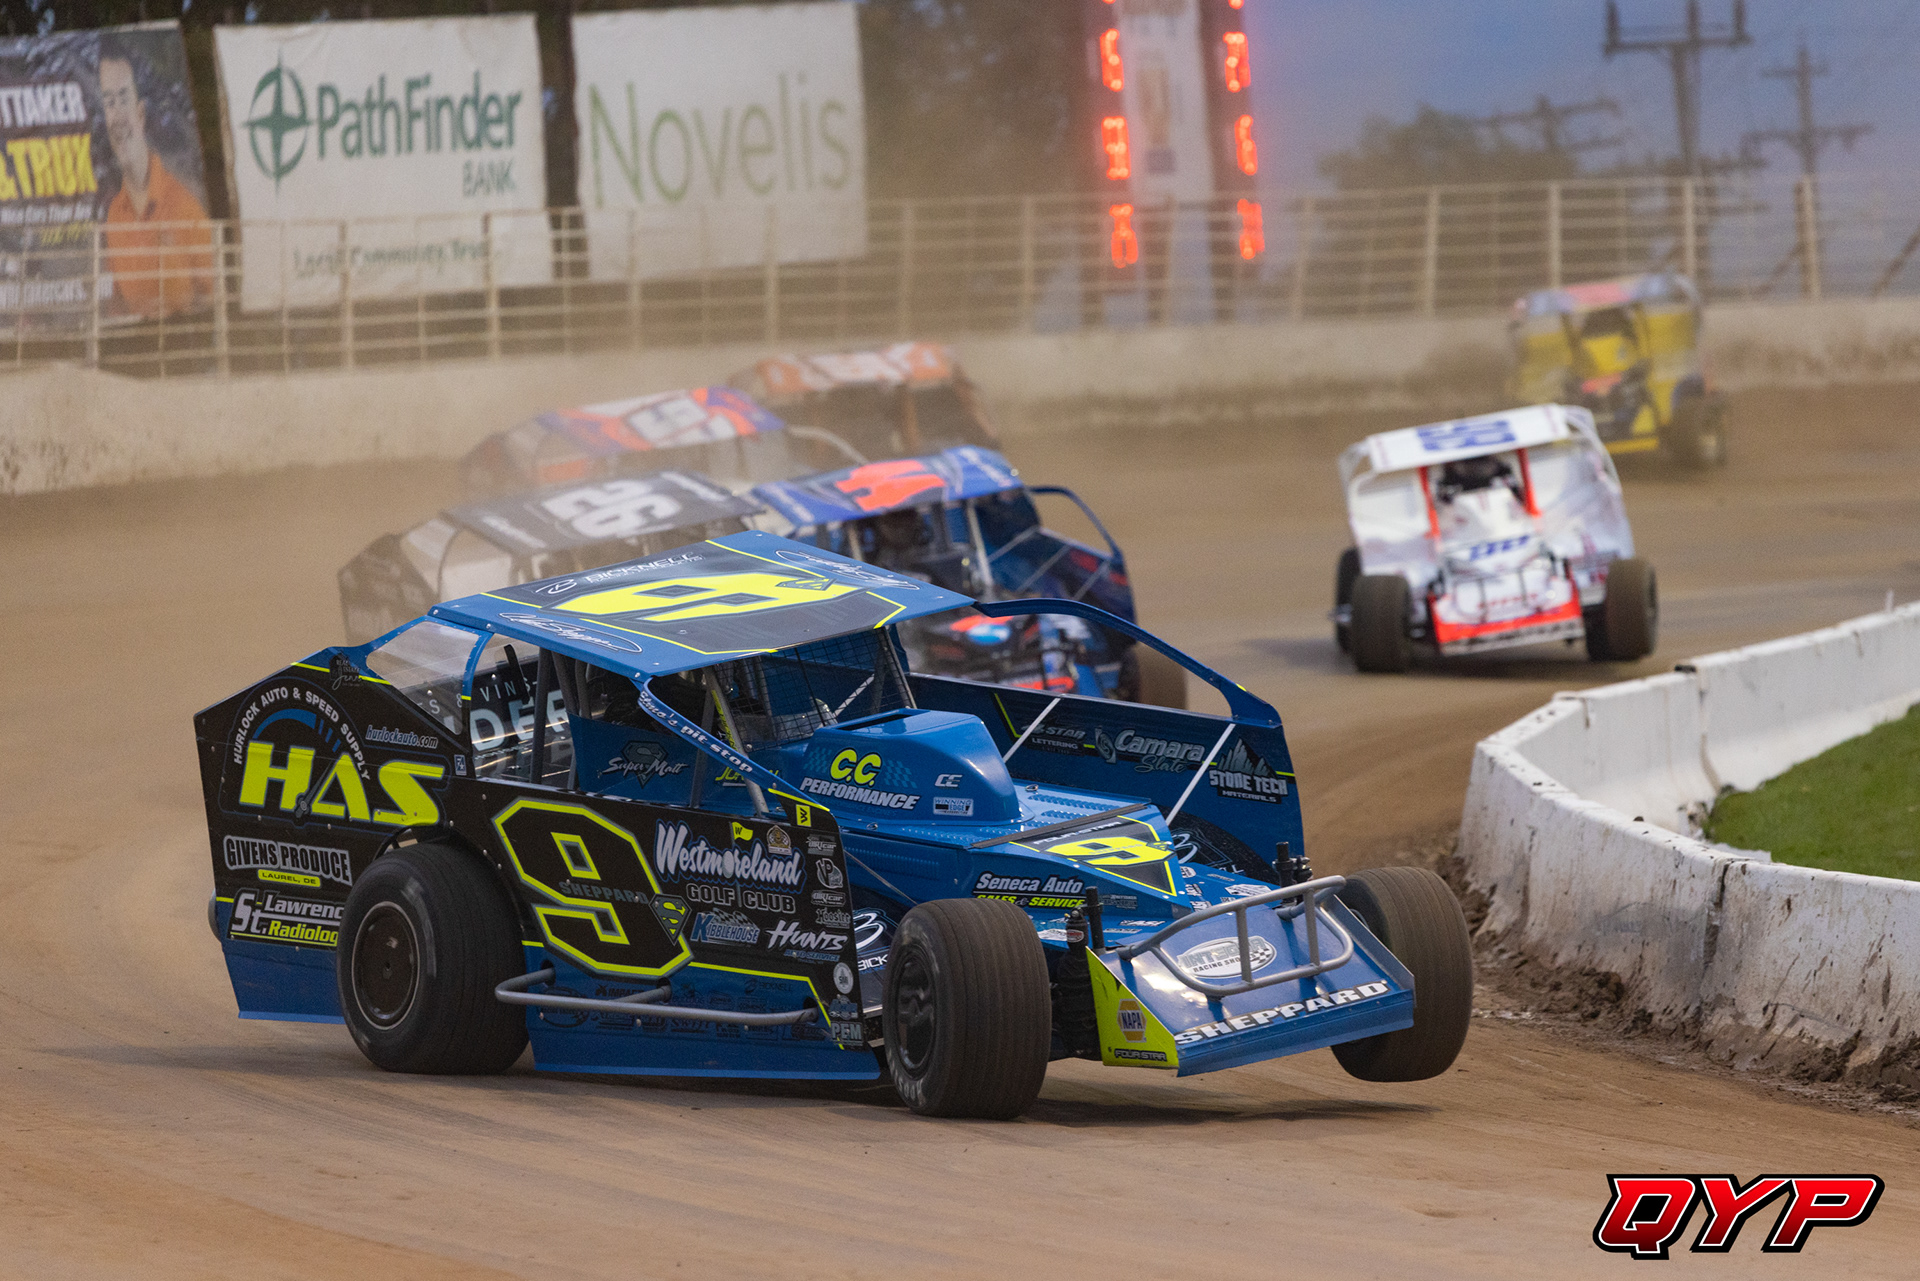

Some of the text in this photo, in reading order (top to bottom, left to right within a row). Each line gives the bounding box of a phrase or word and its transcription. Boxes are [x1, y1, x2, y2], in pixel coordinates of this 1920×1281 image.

[0, 82, 88, 128] TTAKER
[316, 70, 523, 161] PathFinder
[588, 74, 850, 205] Novelis
[6, 132, 98, 199] TRUX
[462, 161, 517, 197] BANK
[551, 572, 860, 624] 9
[233, 687, 371, 781] HURLOCK AUTO & SPEED SUPPLY
[365, 724, 439, 749] hurlockauto.com
[1032, 737, 1078, 750] LETTERING
[1113, 729, 1205, 762] Camara
[1134, 754, 1188, 774] Slate
[239, 741, 445, 827] HAS
[800, 777, 921, 810] PERFORMANCE
[1208, 769, 1288, 796] STONE TECH
[1222, 790, 1277, 803] MATERIALS
[225, 837, 351, 884] GIVENS PRODUCE
[656, 821, 802, 886] Westmoreland
[1045, 836, 1175, 866] 9
[262, 872, 317, 885] LAUREL, DE
[492, 800, 694, 979] 9
[559, 881, 649, 905] SHEPPARD
[976, 873, 1084, 894] Seneca Auto
[264, 896, 345, 920] Lawrenc
[686, 882, 797, 914] GOLF CLUB
[1028, 896, 1086, 908] SERVICE
[268, 920, 338, 945] Radiolog
[690, 912, 760, 944] KIBBLEHOUSE
[805, 951, 841, 962] SERVICE
[1193, 961, 1223, 973] RACING
[1121, 1011, 1143, 1030] NAPA
[1174, 982, 1391, 1046] SHEPPARD
[831, 1022, 862, 1040] PEM
